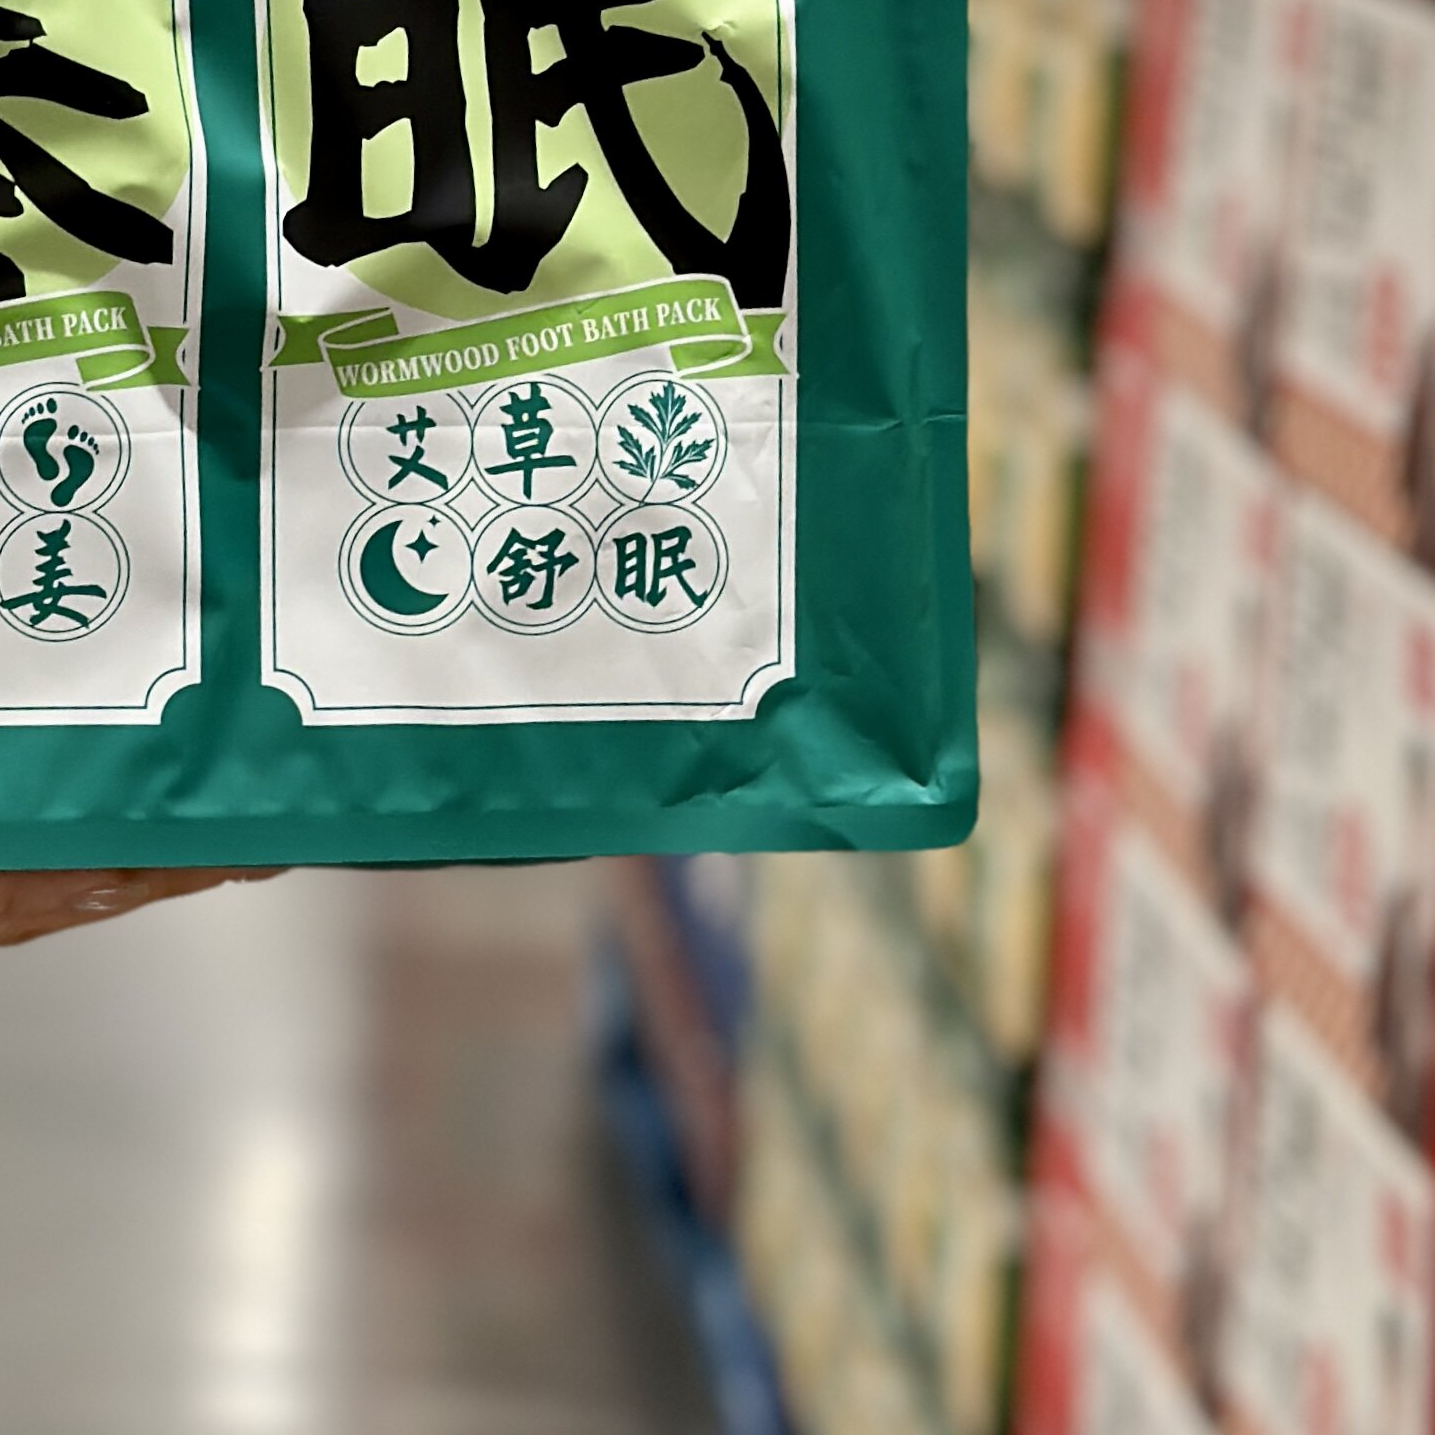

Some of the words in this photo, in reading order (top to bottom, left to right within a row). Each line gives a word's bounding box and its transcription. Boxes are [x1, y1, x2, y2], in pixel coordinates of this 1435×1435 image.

[63, 305, 127, 338] PACK
[336, 342, 500, 389] WORMWOOD
[507, 323, 574, 361] FOOT
[582, 311, 651, 343] BATH
[656, 297, 722, 328] PACK
[386, 382, 578, 501] 艾草
[485, 524, 709, 611] 舒眠
